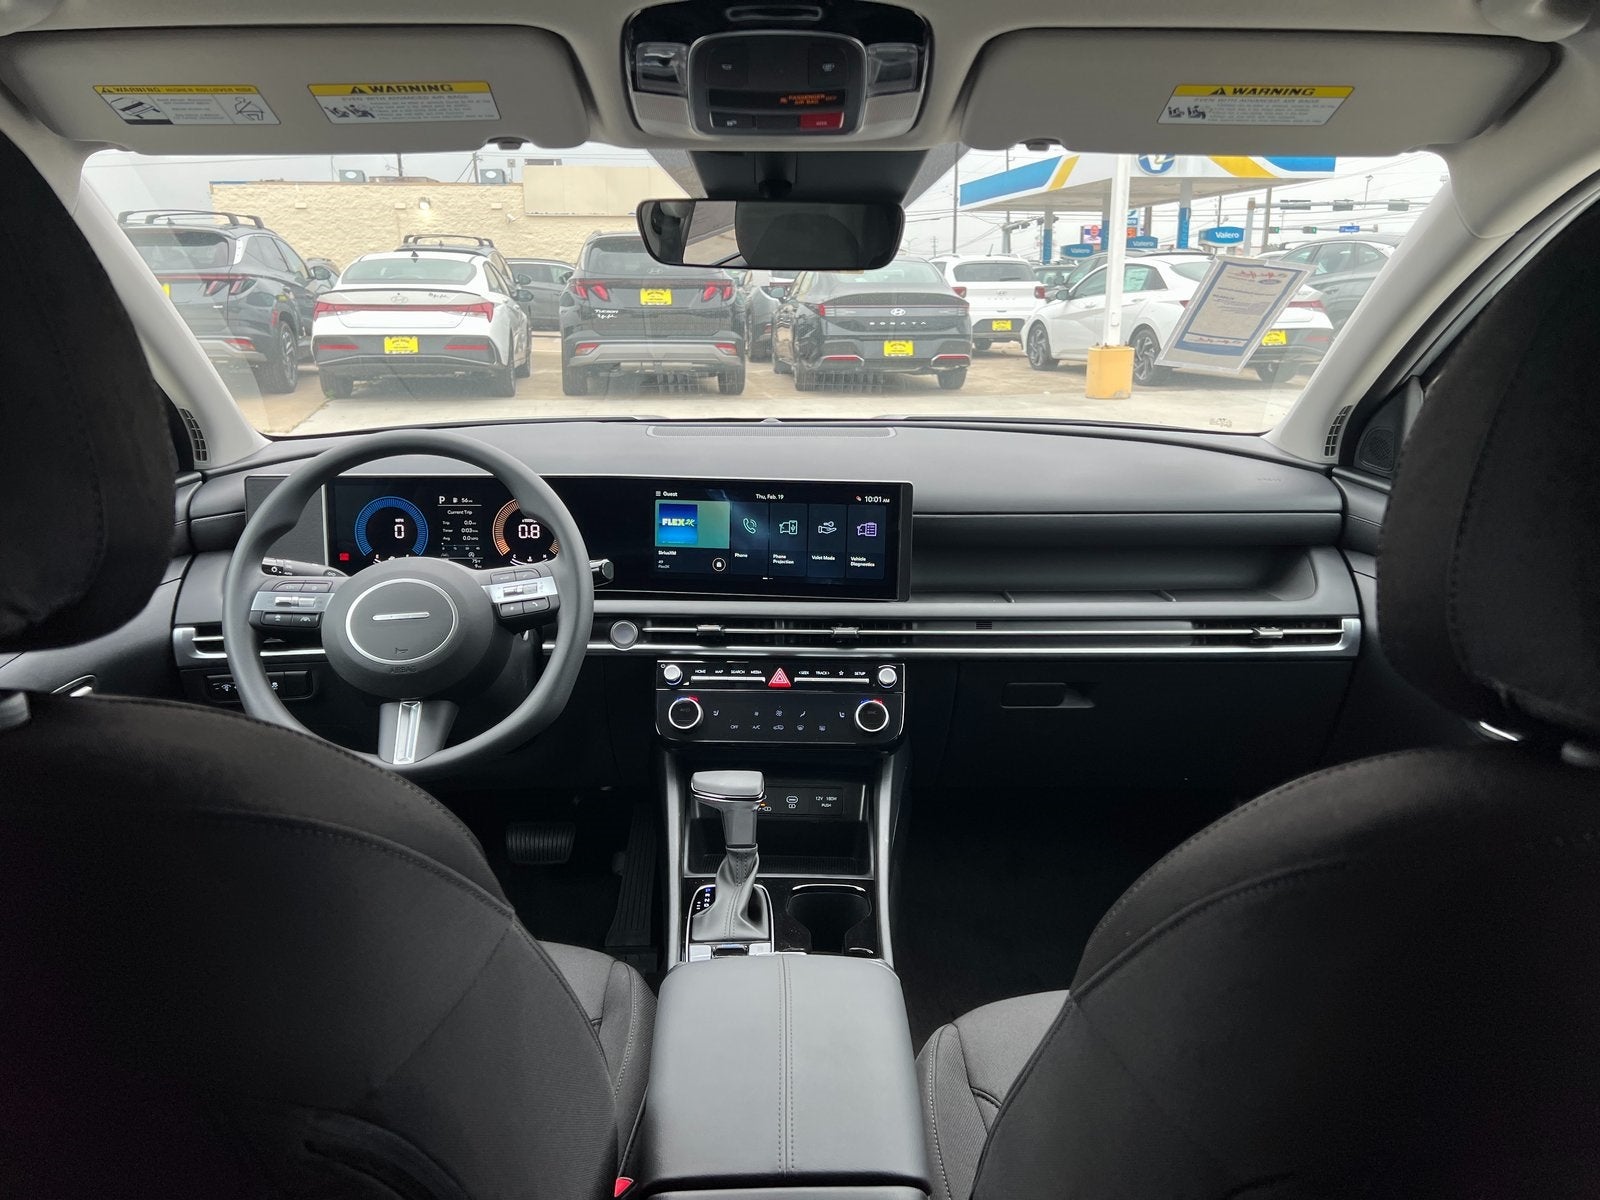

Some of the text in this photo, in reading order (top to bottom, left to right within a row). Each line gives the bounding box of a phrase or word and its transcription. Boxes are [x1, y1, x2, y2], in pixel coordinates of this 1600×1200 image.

[368, 84, 454, 93] WARNING
[1232, 87, 1316, 96] WARNING
[1215, 231, 1240, 239] Valero
[439, 496, 445, 504] P
[394, 524, 405, 539] 0
[518, 524, 540, 539] 0.8
